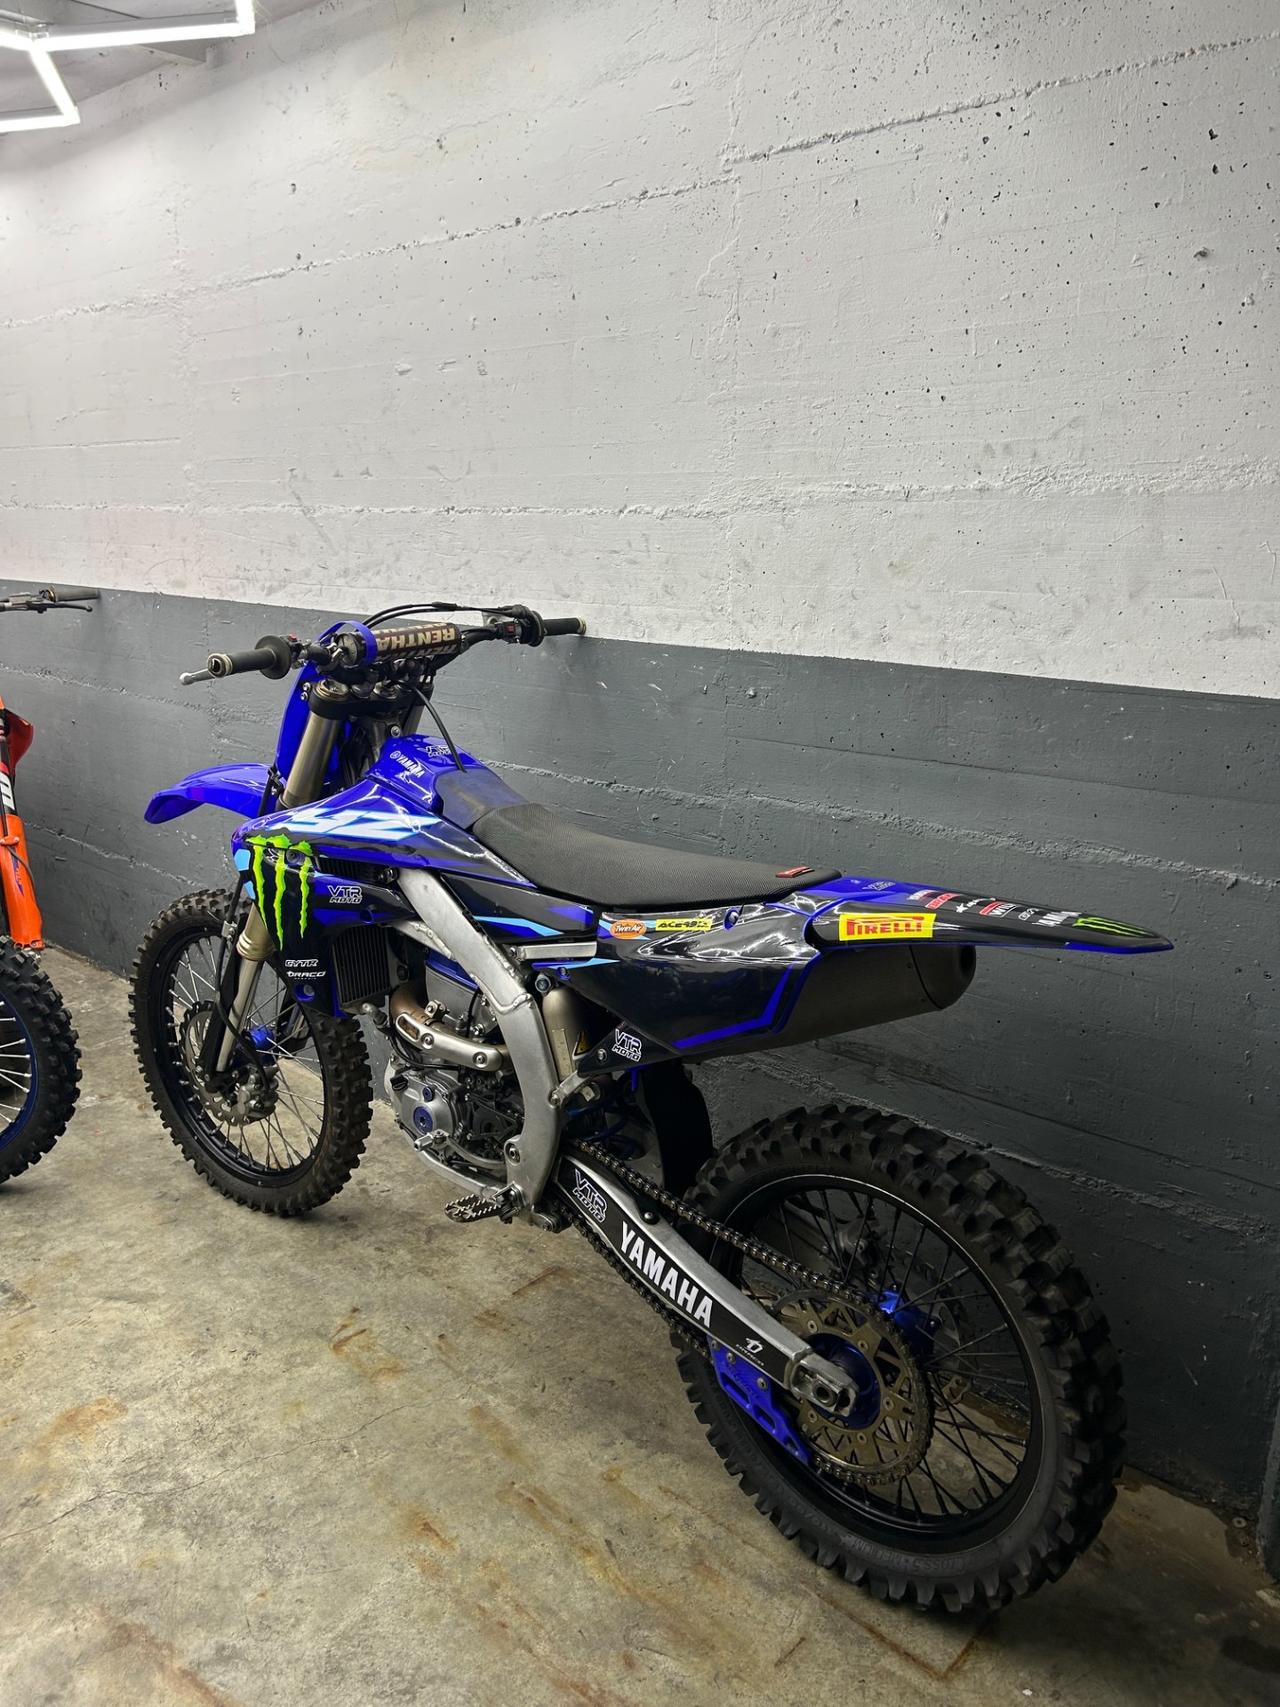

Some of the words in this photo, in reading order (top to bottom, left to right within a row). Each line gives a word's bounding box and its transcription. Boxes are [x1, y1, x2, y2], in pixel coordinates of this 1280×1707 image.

[376, 627, 456, 652] RENTHA
[327, 885, 363, 898] VTR
[329, 896, 363, 905] MOTO
[846, 916, 924, 936] PIRELLI
[285, 958, 319, 968] GYTR
[286, 970, 327, 978] DRACO
[614, 1028, 642, 1055] VTR
[611, 1043, 642, 1062] MOTO
[574, 1168, 608, 1216] VTR
[572, 1187, 606, 1223] MOTO
[621, 1220, 713, 1328] YAMAHA
